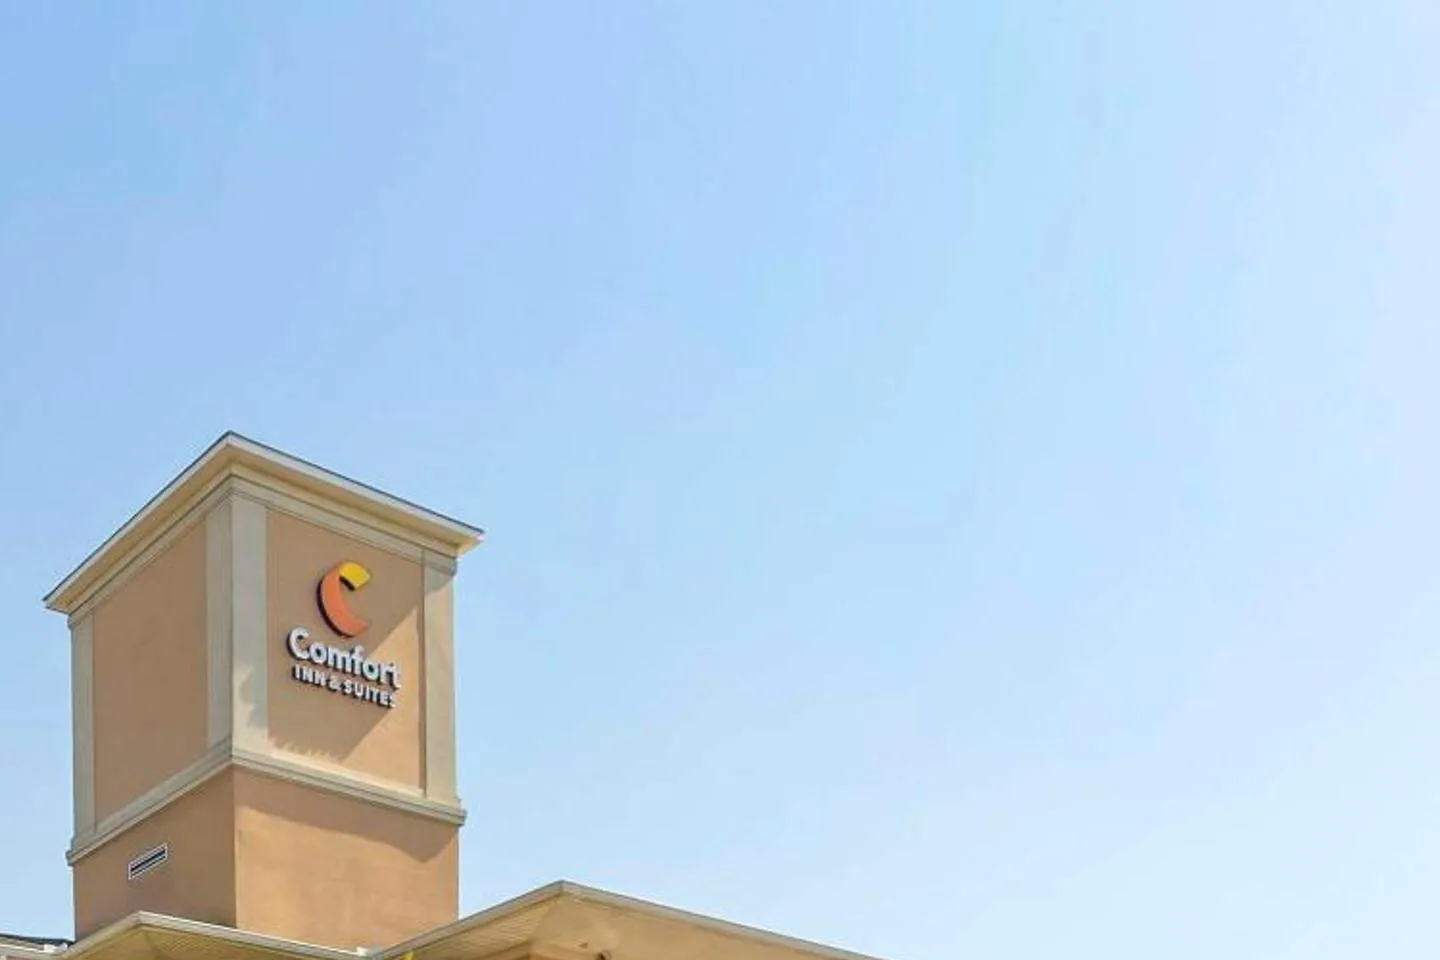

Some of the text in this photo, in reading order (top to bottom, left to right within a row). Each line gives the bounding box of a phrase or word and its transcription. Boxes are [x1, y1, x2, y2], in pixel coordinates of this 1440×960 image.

[288, 626, 402, 690] Comfort
[293, 663, 396, 709] INN & SUITES
